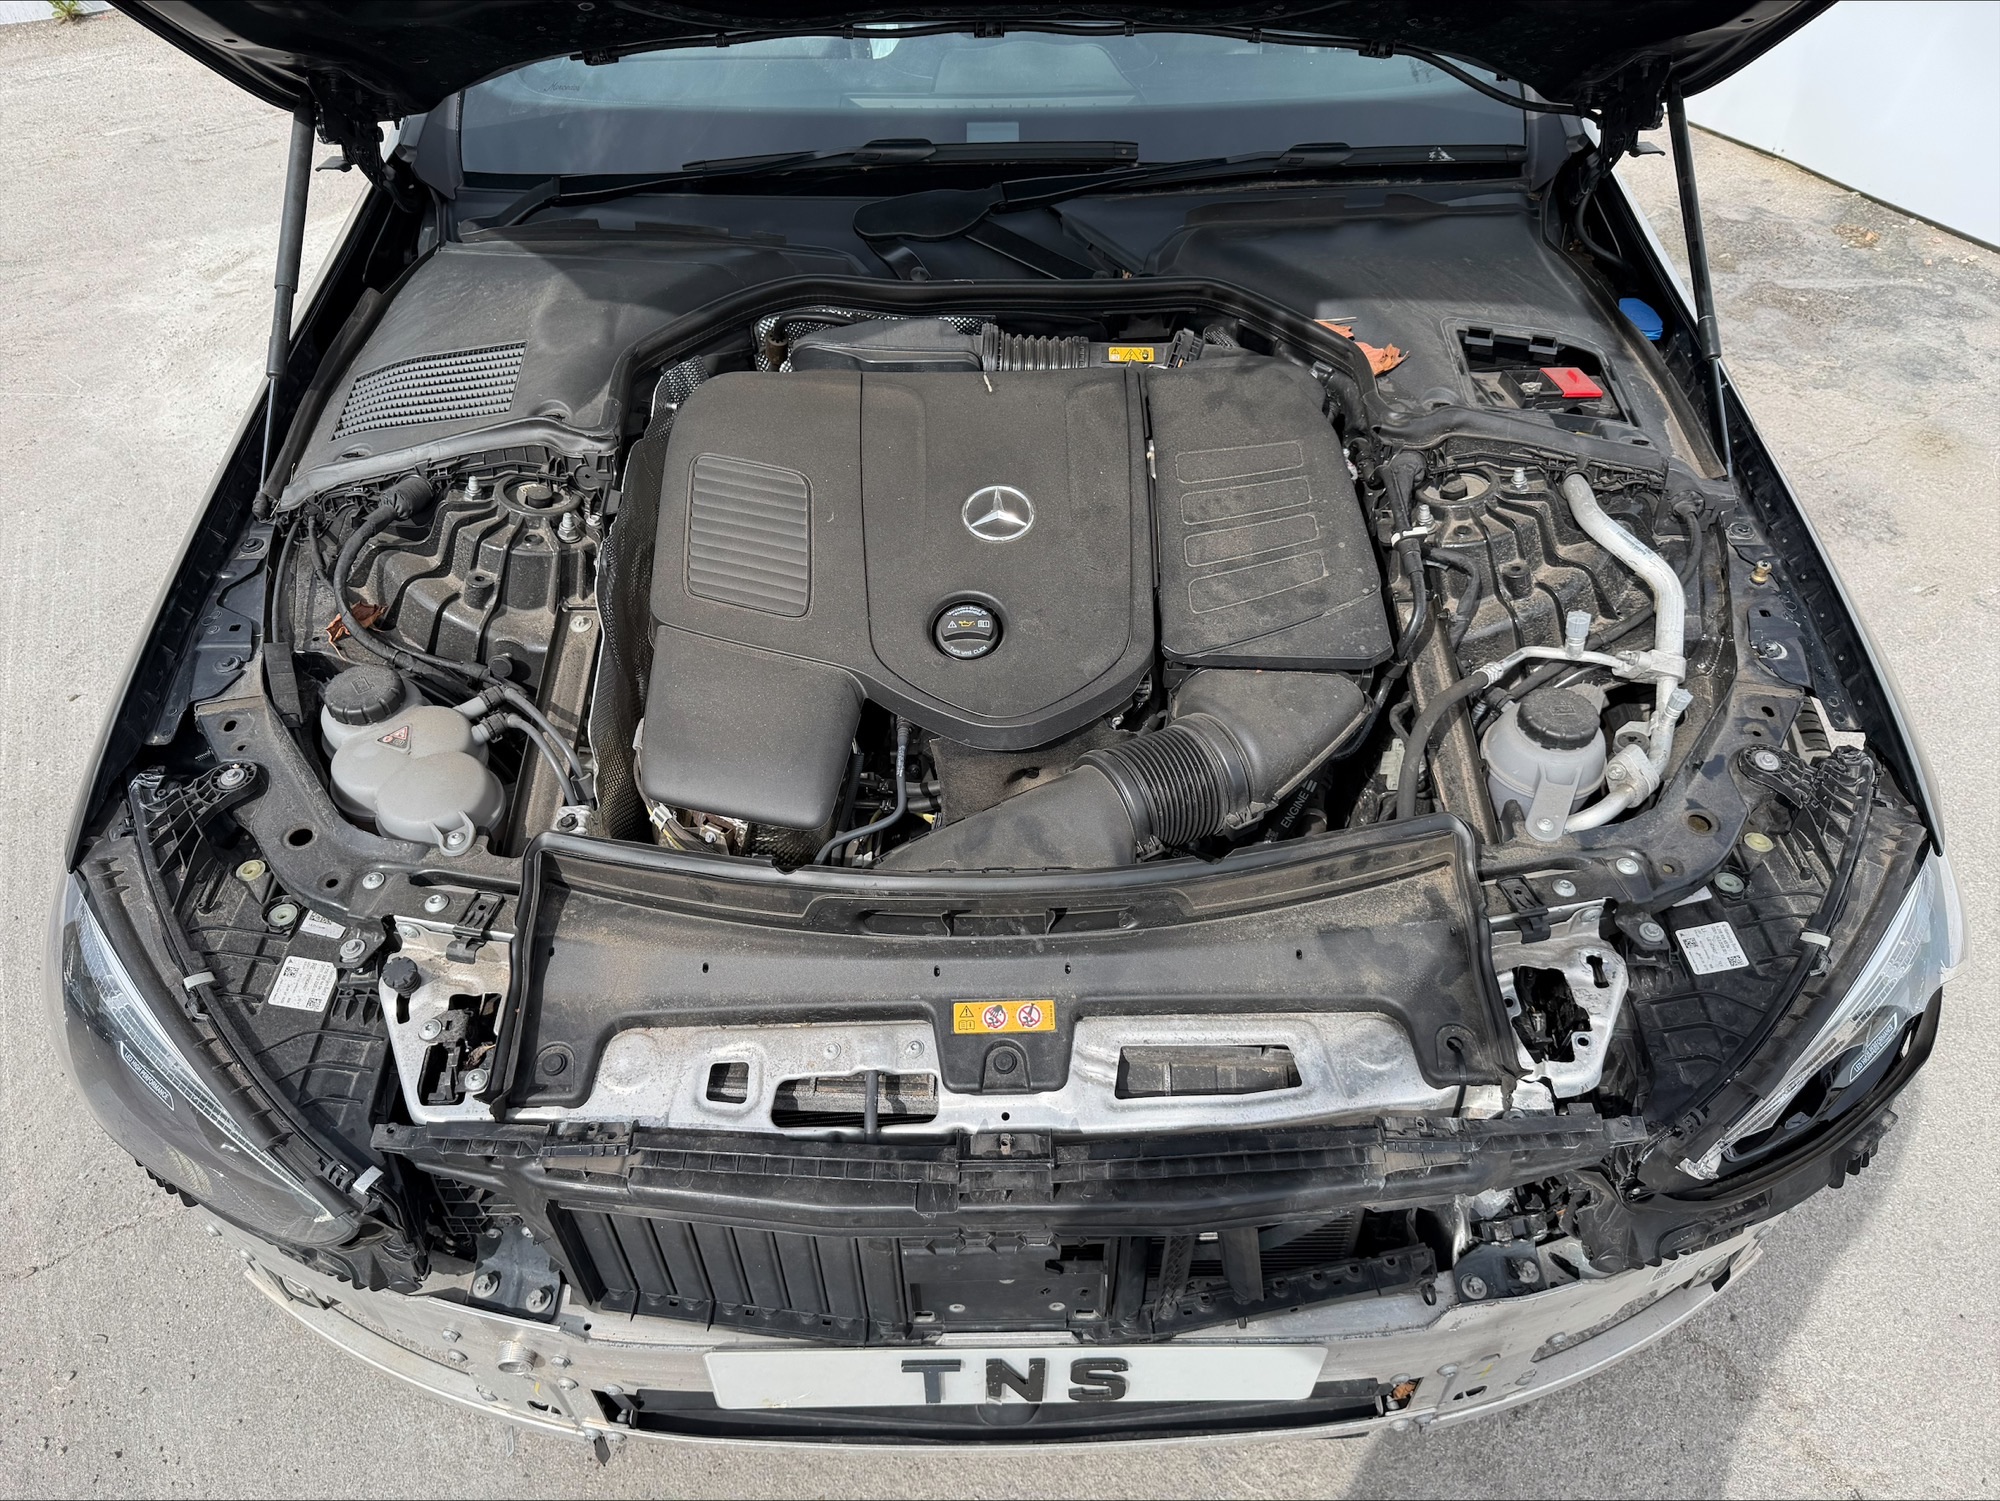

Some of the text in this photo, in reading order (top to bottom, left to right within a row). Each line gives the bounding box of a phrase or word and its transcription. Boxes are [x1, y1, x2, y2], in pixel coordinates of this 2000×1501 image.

[1281, 792, 1309, 829] ENGINE
[124, 1052, 169, 1101] LED HIGH PERFORMANCE
[1853, 1062, 1863, 1073] LED
[902, 1357, 1129, 1403] TNS
